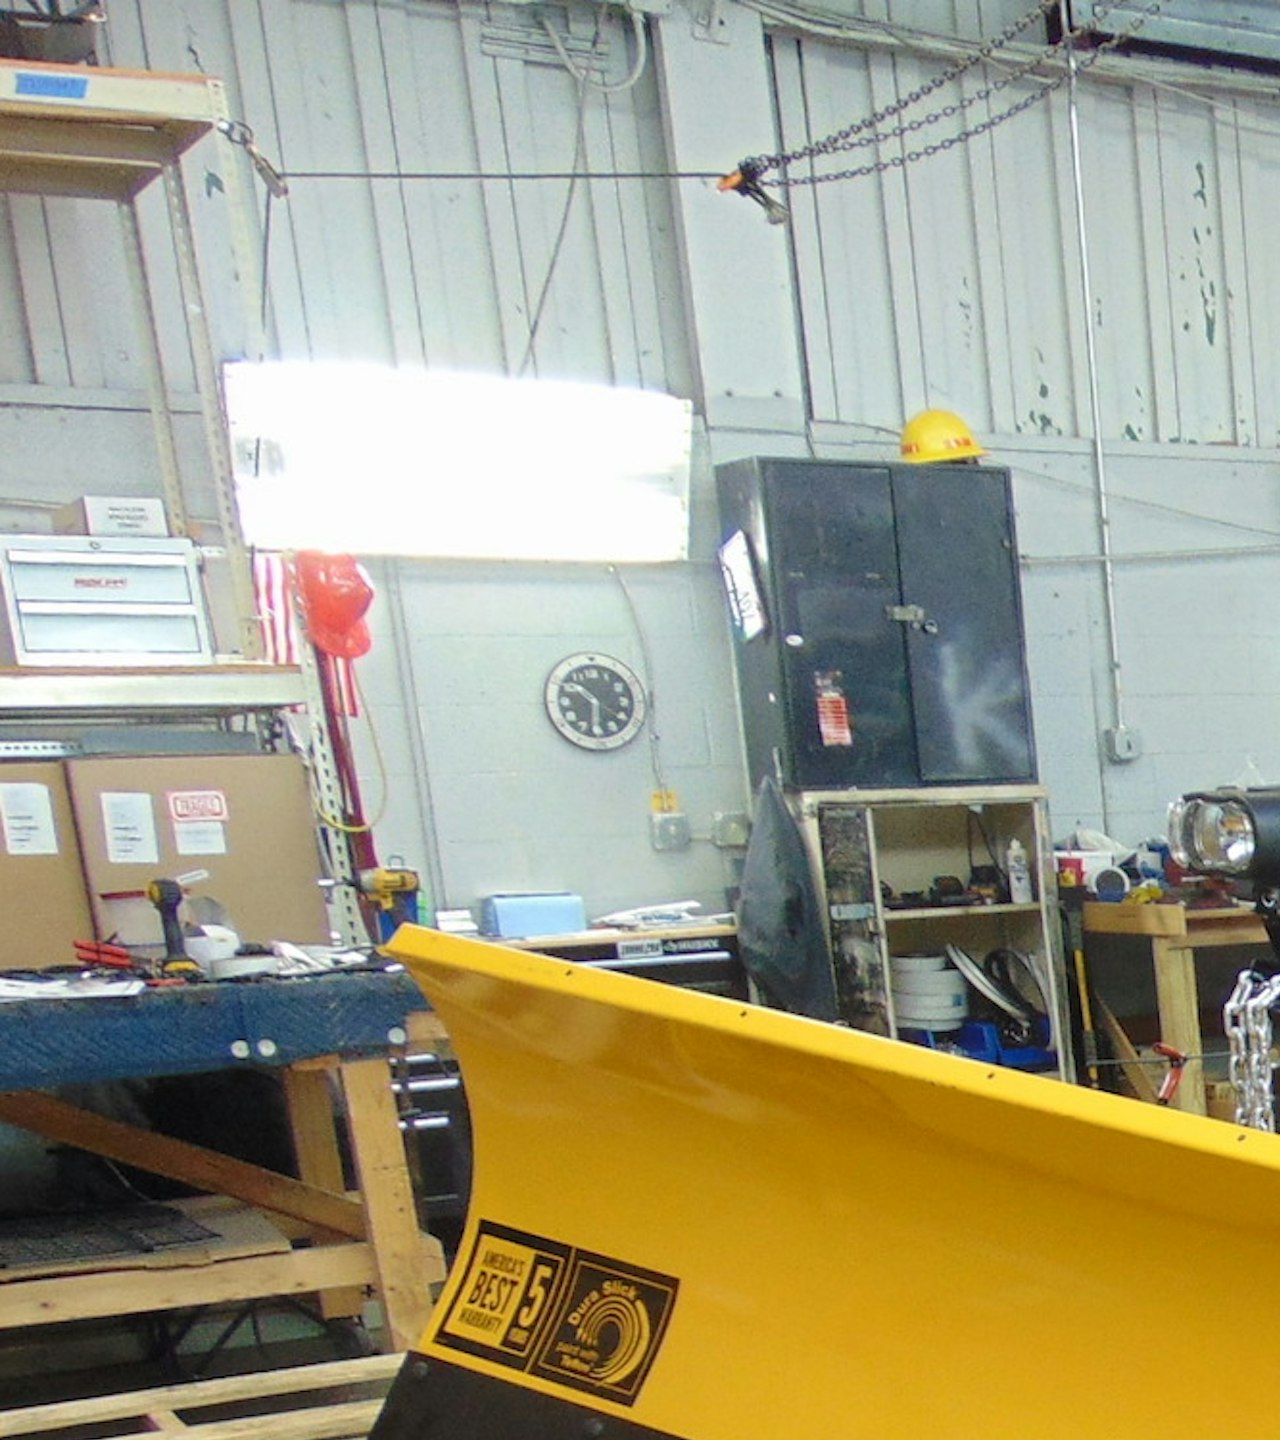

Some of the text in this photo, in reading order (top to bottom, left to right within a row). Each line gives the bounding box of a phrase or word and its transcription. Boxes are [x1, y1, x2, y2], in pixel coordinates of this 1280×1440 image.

[467, 1270, 520, 1315] BEST
[518, 1264, 553, 1328] 5
[567, 1280, 639, 1326] Dura Slick
